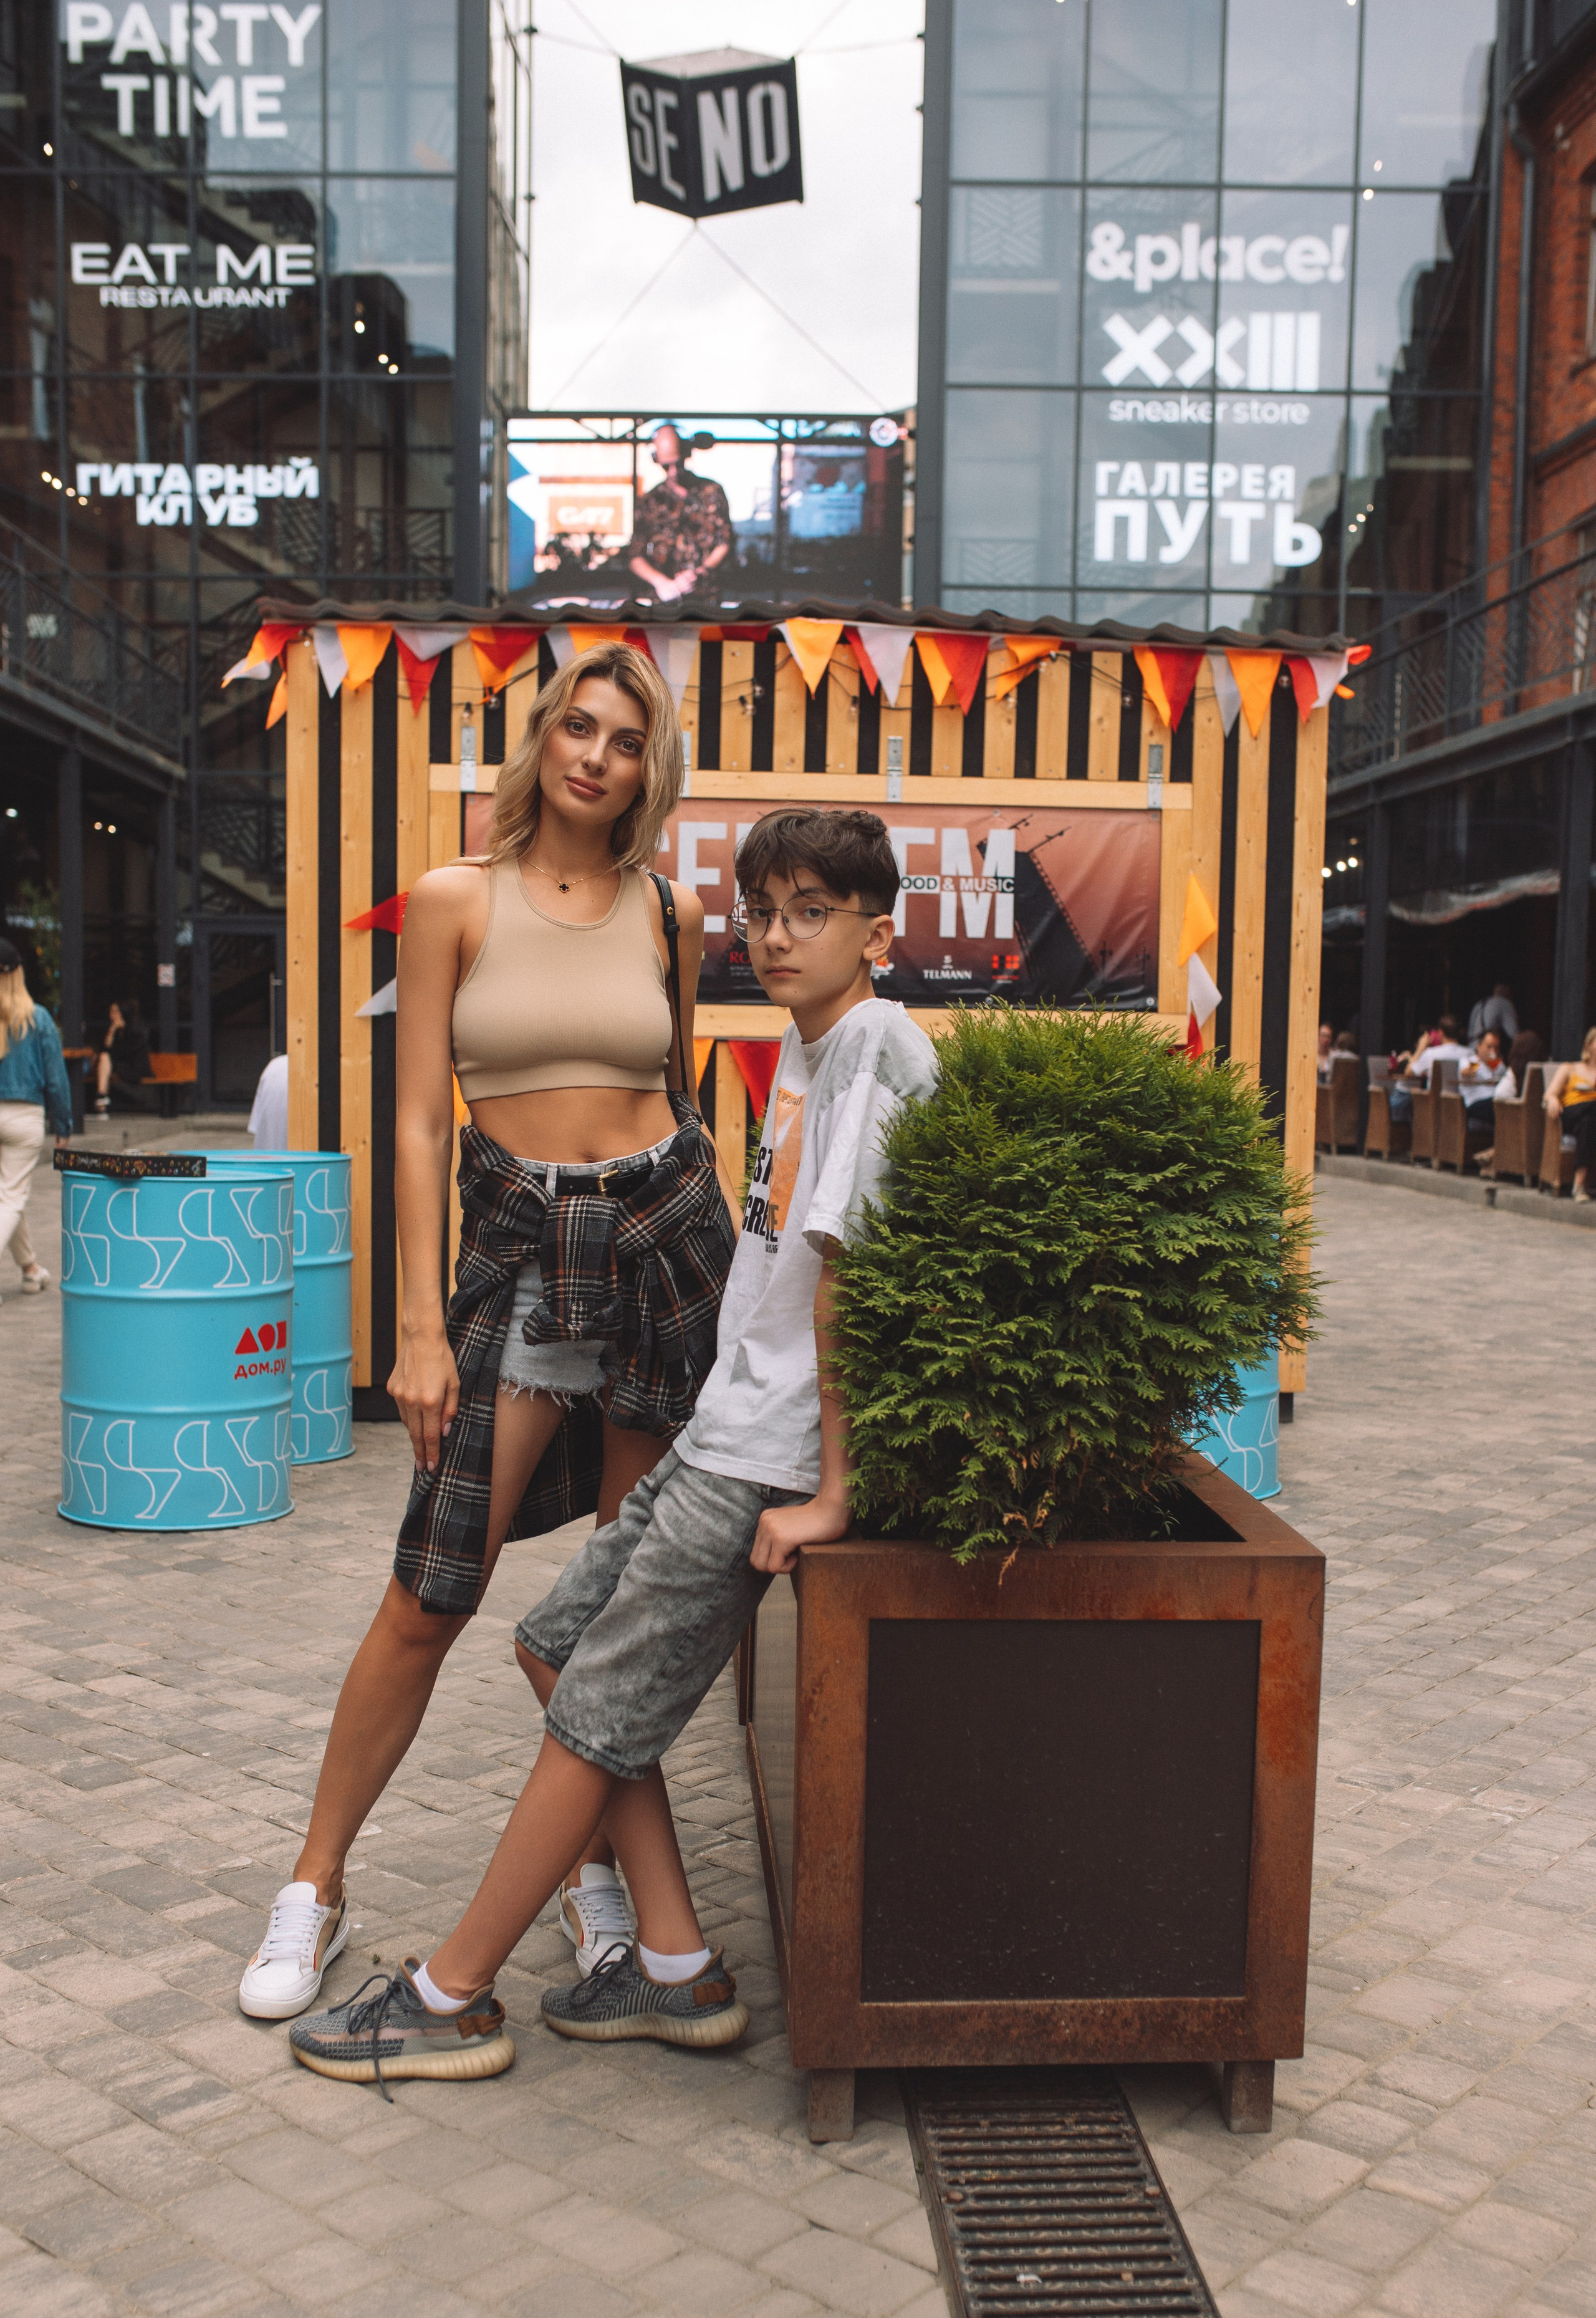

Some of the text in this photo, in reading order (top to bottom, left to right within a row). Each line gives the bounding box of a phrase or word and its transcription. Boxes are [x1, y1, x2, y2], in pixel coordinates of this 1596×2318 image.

[67, 3, 321, 67] PARTY
[101, 74, 288, 137] TIME
[70, 243, 316, 285] EAT ME
[1086, 221, 1350, 292] &place!
[100, 286, 292, 309] RESTAURANT
[1102, 312, 1320, 391] XXIII
[1108, 395, 1309, 425] sneaker store
[76, 456, 320, 499] ГИТАРНЫЙ
[1095, 461, 1296, 500] ГАЛЕРЕЯ
[136, 495, 258, 526] КЛУБ
[1094, 499, 1322, 567] ПУТЬ
[900, 876, 1015, 893] OOD & MUSIC
[923, 969, 972, 980] TELMANN
